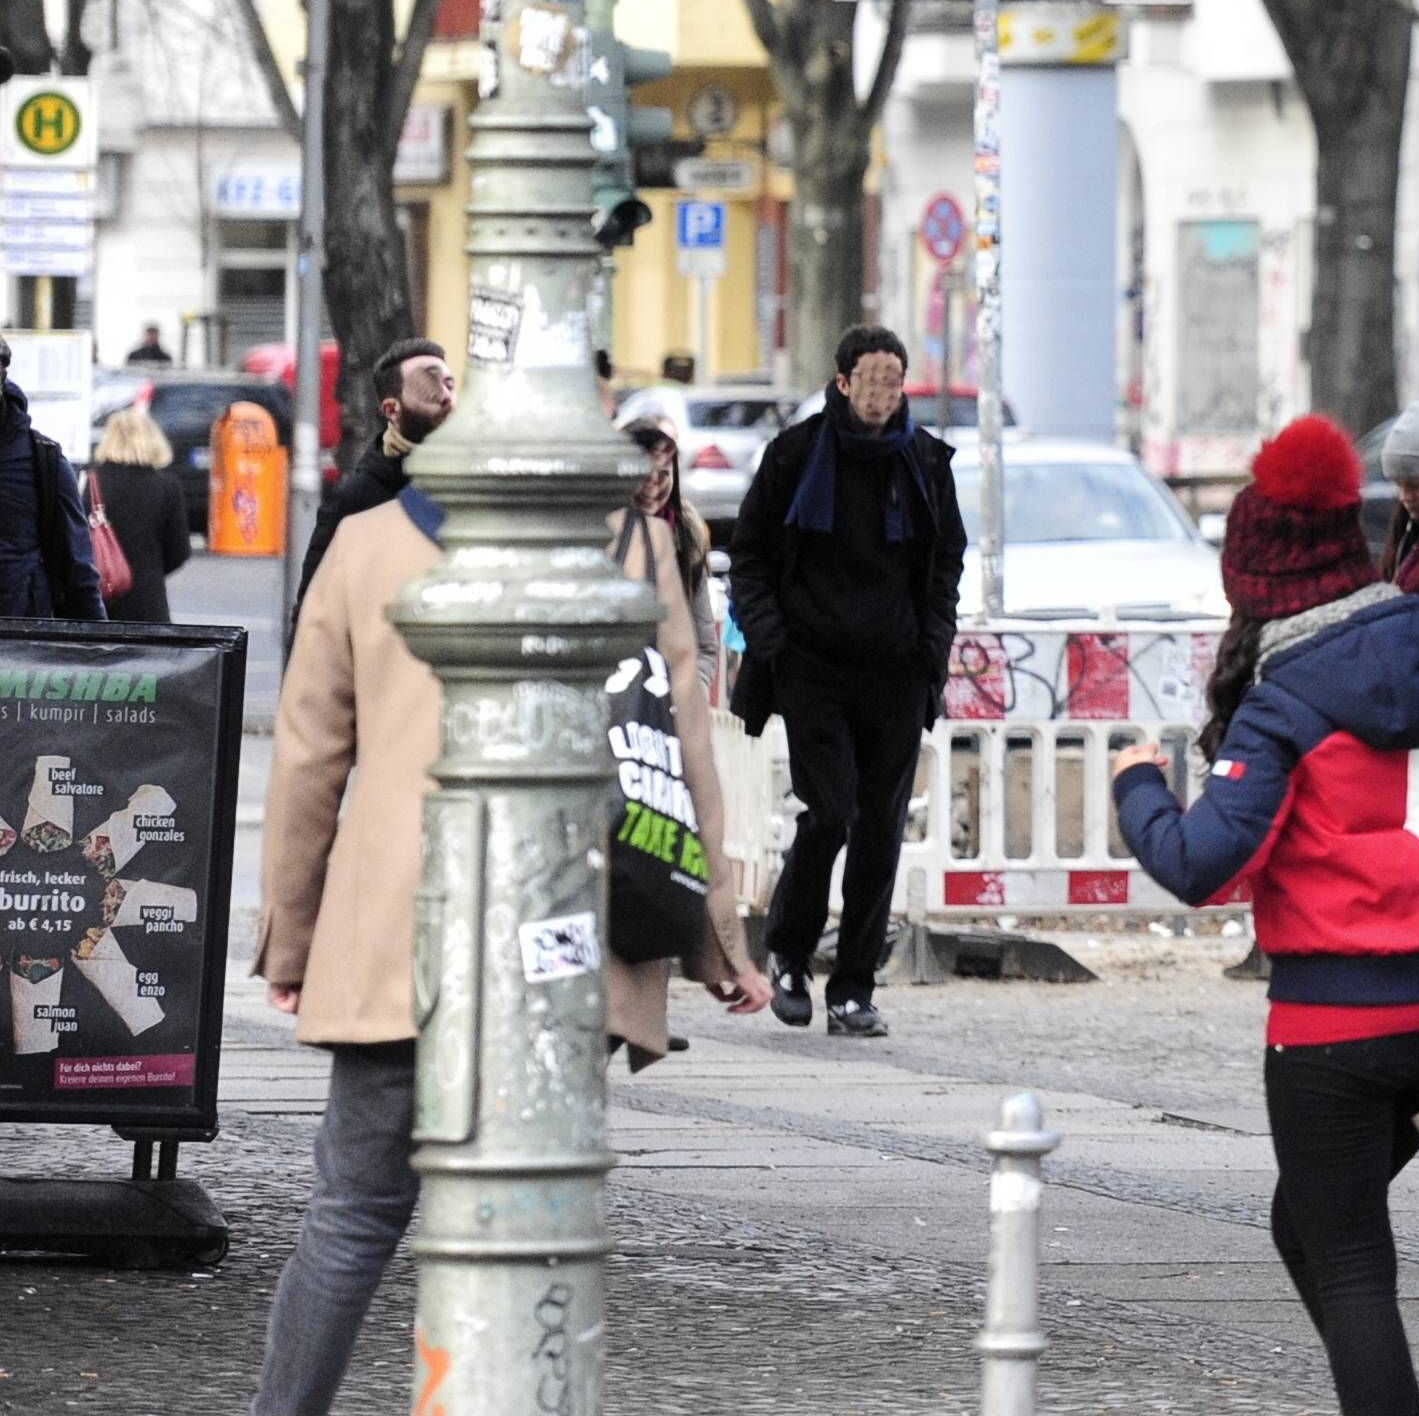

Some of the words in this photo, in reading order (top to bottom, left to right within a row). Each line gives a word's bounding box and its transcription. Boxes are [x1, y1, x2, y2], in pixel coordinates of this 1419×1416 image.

[35, 108, 64, 138] H
[30, 704, 87, 724] kumpir
[106, 706, 156, 724] salads
[51, 768, 76, 781] beef
[54, 781, 104, 795] salvatore
[136, 816, 175, 828] chicken
[139, 830, 185, 843] gonzales
[45, 871, 86, 884] lecker
[0, 887, 86, 912] burrito
[142, 906, 173, 920] veggi
[8, 918, 25, 930] ab
[29, 918, 37, 930] €
[41, 919, 72, 933] 4,15
[146, 920, 184, 934] pancho
[138, 972, 159, 985] egg
[140, 985, 166, 997] enzo
[36, 1007, 76, 1019] salmon
[53, 1020, 77, 1033] juan
